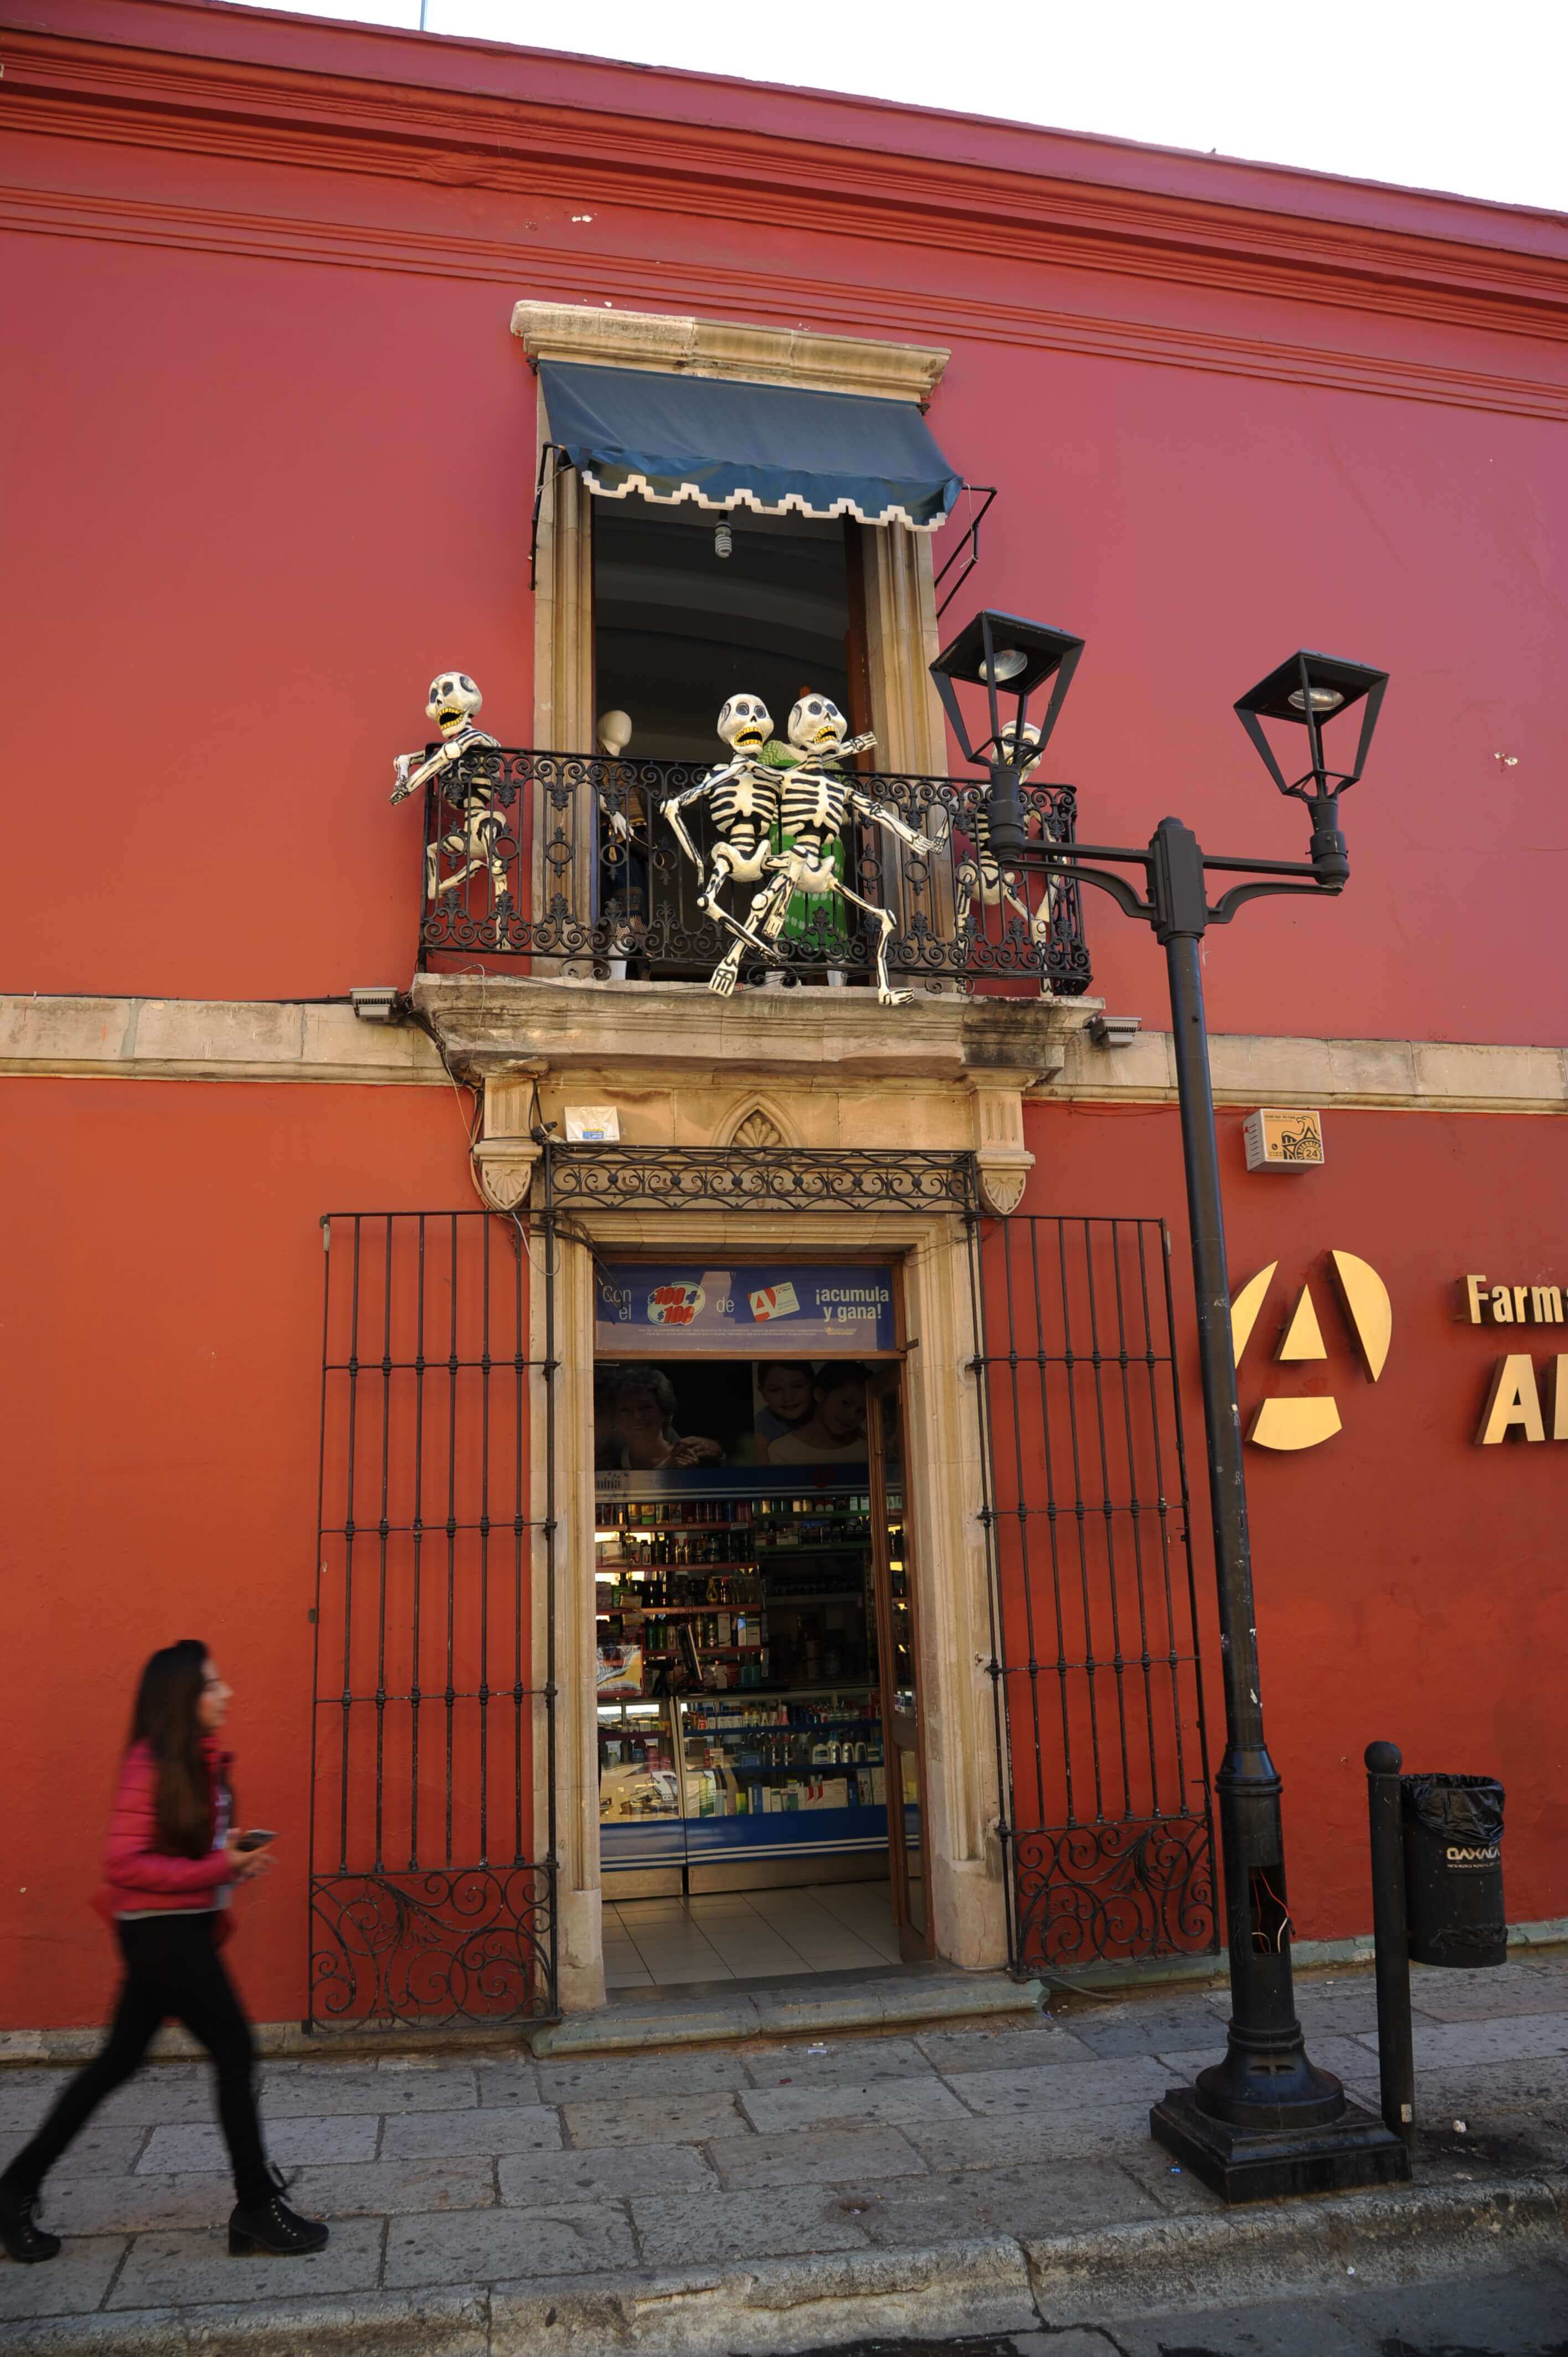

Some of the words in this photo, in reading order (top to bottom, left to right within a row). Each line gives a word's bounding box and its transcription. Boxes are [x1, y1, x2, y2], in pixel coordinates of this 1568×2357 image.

[1306, 1149, 1318, 1157] 24
[602, 1285, 632, 1303] Con
[816, 1285, 889, 1305] ¡acumula
[1467, 1274, 1568, 1324] Farm
[619, 1303, 632, 1320] el
[716, 1296, 735, 1313] de
[823, 1306, 833, 1322] y
[837, 1303, 881, 1322] gana!
[657, 1306, 695, 1324] $100
[1447, 1846, 1500, 1860] OAXACA
